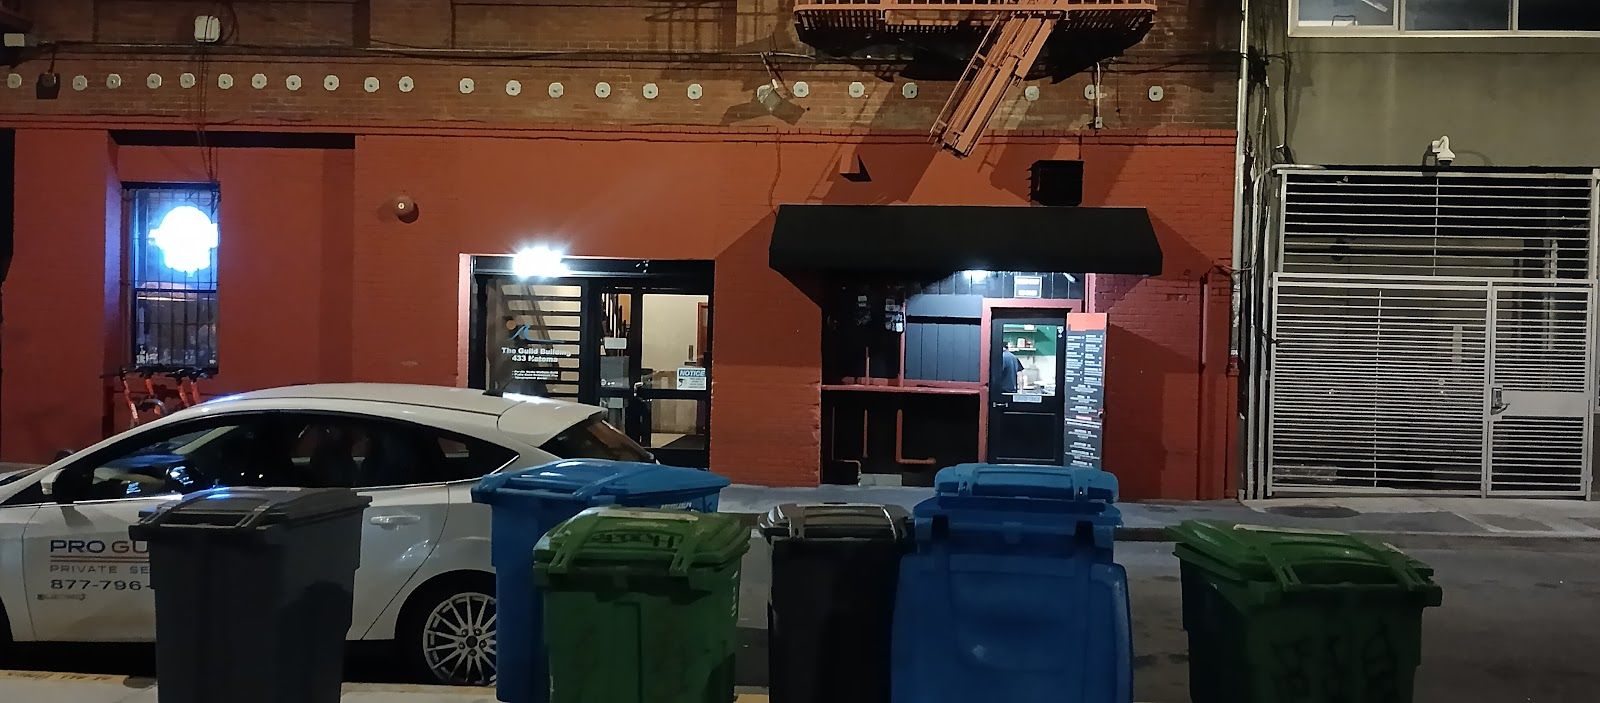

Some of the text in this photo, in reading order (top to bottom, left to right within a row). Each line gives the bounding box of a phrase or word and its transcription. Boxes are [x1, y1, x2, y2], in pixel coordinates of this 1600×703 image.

[518, 347, 538, 355] Guild
[540, 348, 572, 357] Building
[512, 354, 527, 362] 433
[50, 540, 106, 553] PRO
[50, 565, 118, 574] PRIVATE
